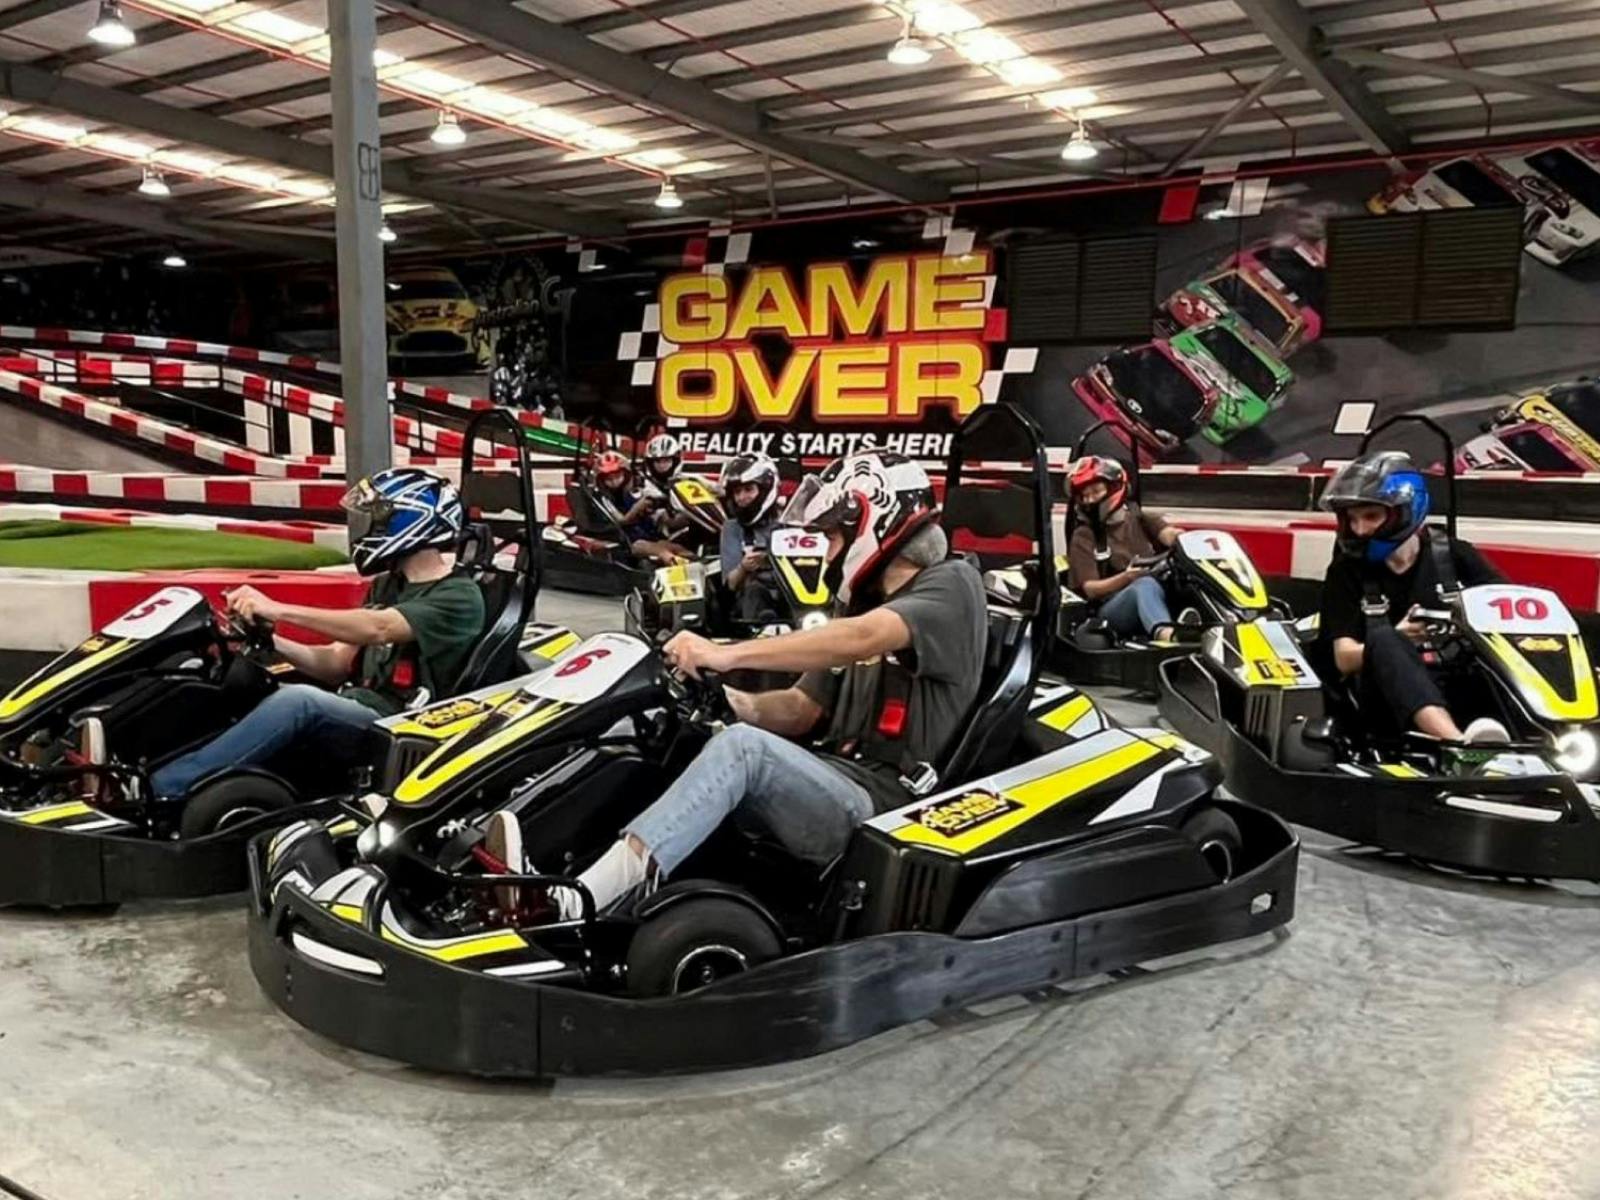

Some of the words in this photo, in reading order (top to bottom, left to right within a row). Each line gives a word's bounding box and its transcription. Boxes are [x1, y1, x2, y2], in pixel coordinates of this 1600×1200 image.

[659, 253, 988, 343] GAME
[659, 341, 985, 418] OVER
[679, 432, 775, 456] REALITY
[780, 432, 877, 457] STARTS
[686, 484, 703, 498] 2
[1203, 537, 1220, 551] 1
[123, 598, 173, 621] 5
[1488, 597, 1549, 620] 10
[554, 648, 612, 677] 6
